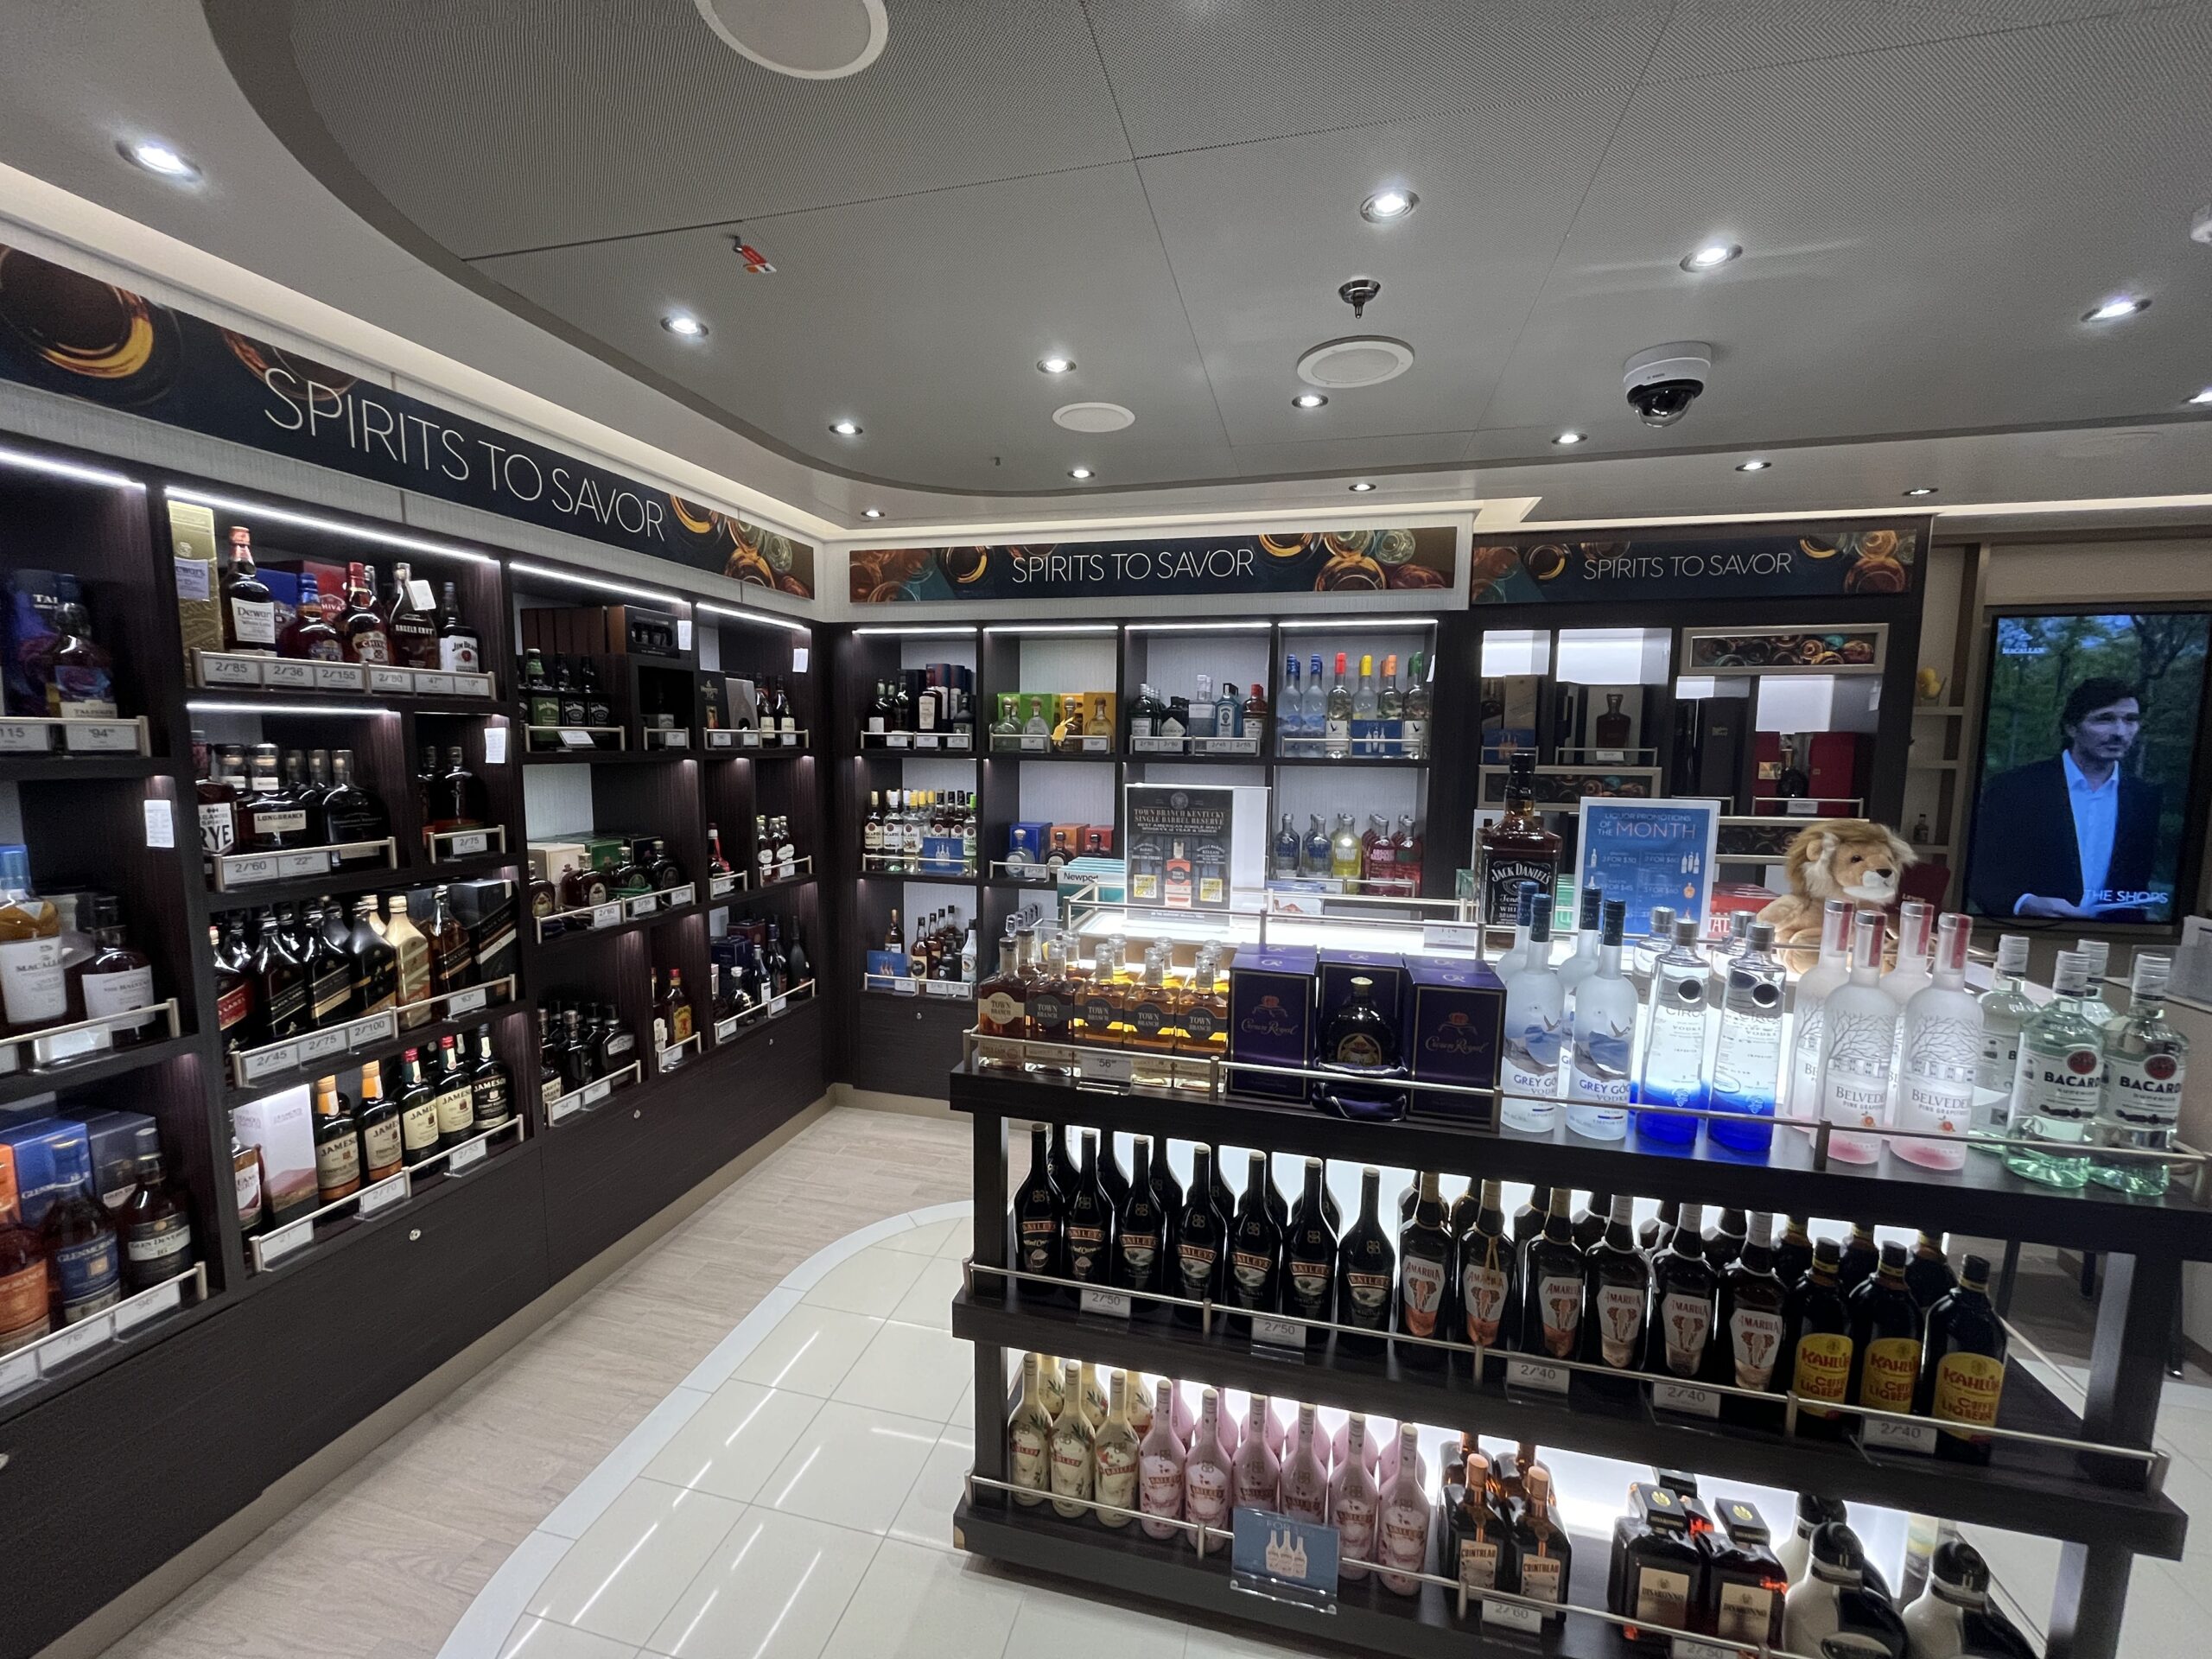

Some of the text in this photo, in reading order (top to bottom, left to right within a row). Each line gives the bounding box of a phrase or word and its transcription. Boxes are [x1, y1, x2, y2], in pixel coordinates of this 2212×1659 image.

[264, 367, 665, 543] SPIRITS TO SAVOR
[1011, 549, 1254, 583] SPIRITS TO SAVOR
[1583, 552, 1792, 580] SPIRITS TO SAVOR
[1156, 809, 1185, 817] BRANCH
[1186, 810, 1225, 819] KENTUCKY
[1616, 822, 1695, 839] MONTH
[1491, 863, 1552, 885] JACK DANIEL'S
[2116, 890, 2169, 906] SHOPS
[990, 1000, 1011, 1009] TOWN
[1037, 1003, 1058, 1014] TOWN
[1087, 1006, 1109, 1016] TOWN
[1137, 1012, 1160, 1021] TOWN
[1189, 1015, 1211, 1026] TOWN
[1241, 1018, 1297, 1036] Crown Royal
[1426, 1036, 1487, 1055] Crown Royal
[1513, 1074, 1540, 1087] GREY
[1580, 1079, 1608, 1094] GREY
[1121, 1236, 1158, 1247] BAILEYS
[1179, 1246, 1215, 1259] BAILEYS
[1232, 1255, 1270, 1268] BAILEYS
[1293, 1264, 1332, 1275] BAILEYS
[1405, 1262, 1441, 1281] AMARULA
[1351, 1275, 1390, 1287] BAILEYS
[1461, 1547, 1497, 1558] COINTREAU
[1522, 1562, 1559, 1573] COINTREAU
[1642, 1587, 1684, 1600] DISARONNO
[1723, 1602, 1767, 1618] DISARONNO
